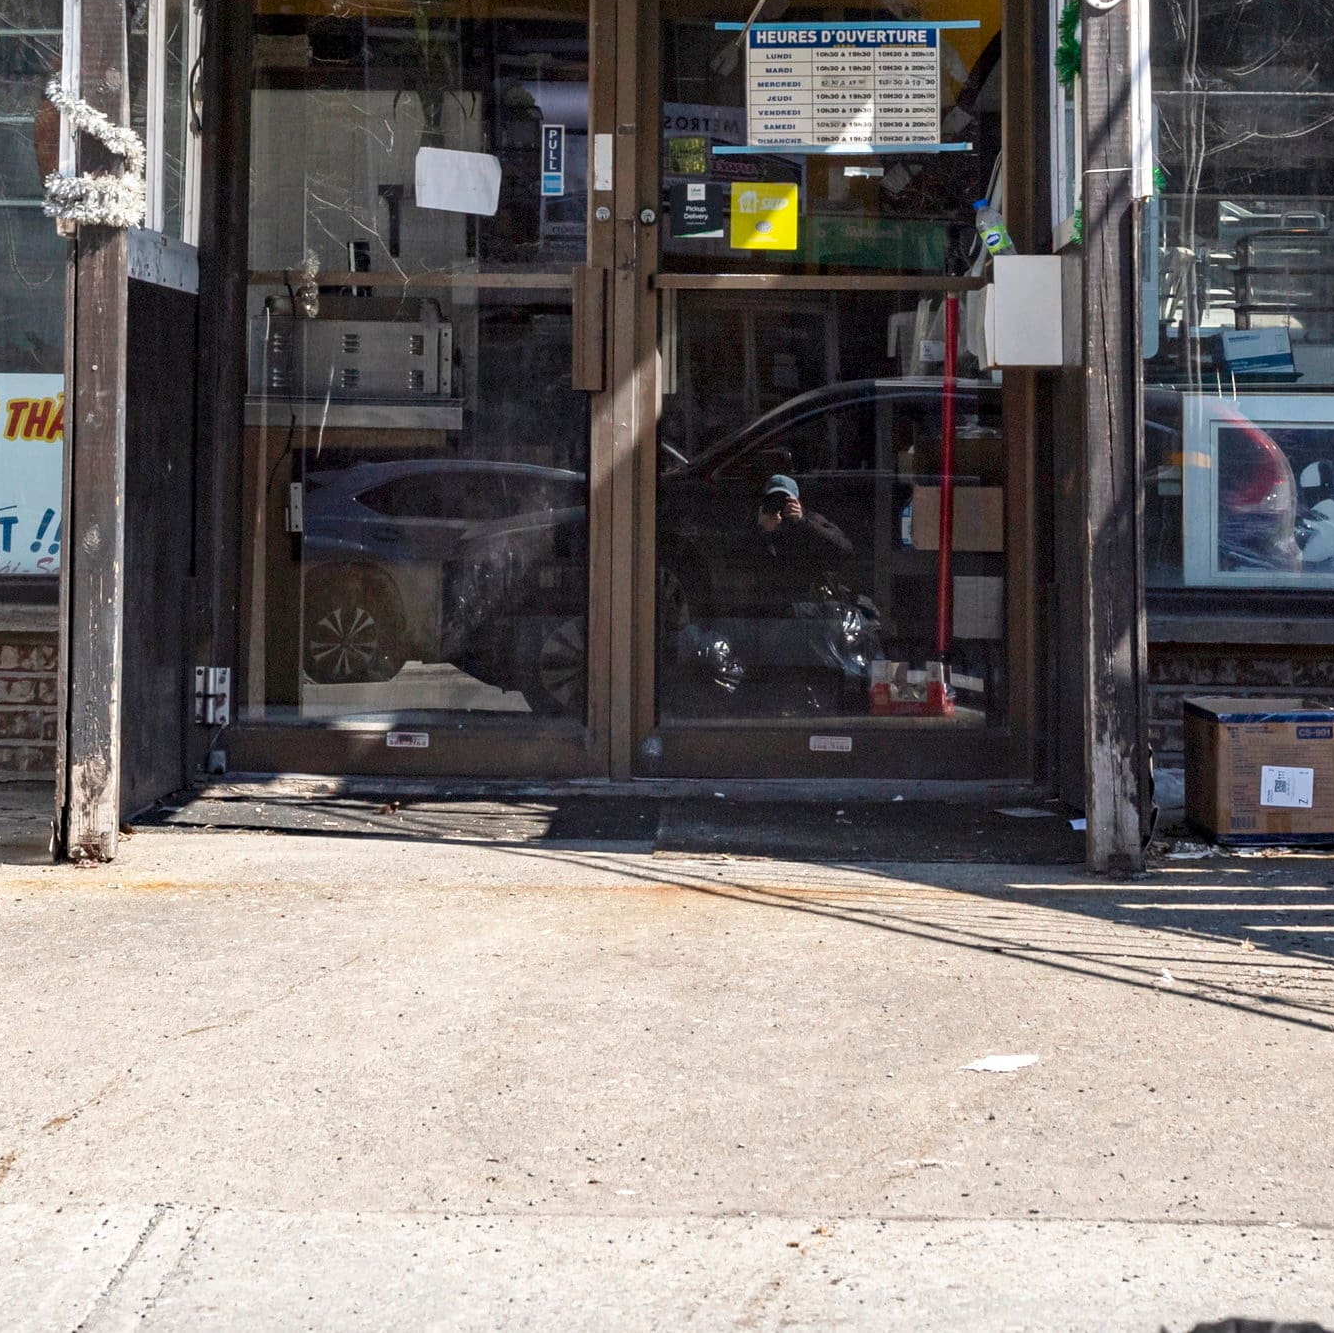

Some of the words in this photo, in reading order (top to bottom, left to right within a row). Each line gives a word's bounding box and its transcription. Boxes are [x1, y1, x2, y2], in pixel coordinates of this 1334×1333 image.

[756, 30, 817, 44] HEURES
[821, 29, 927, 44] D'OUVERTURE
[548, 129, 558, 171] PULL
